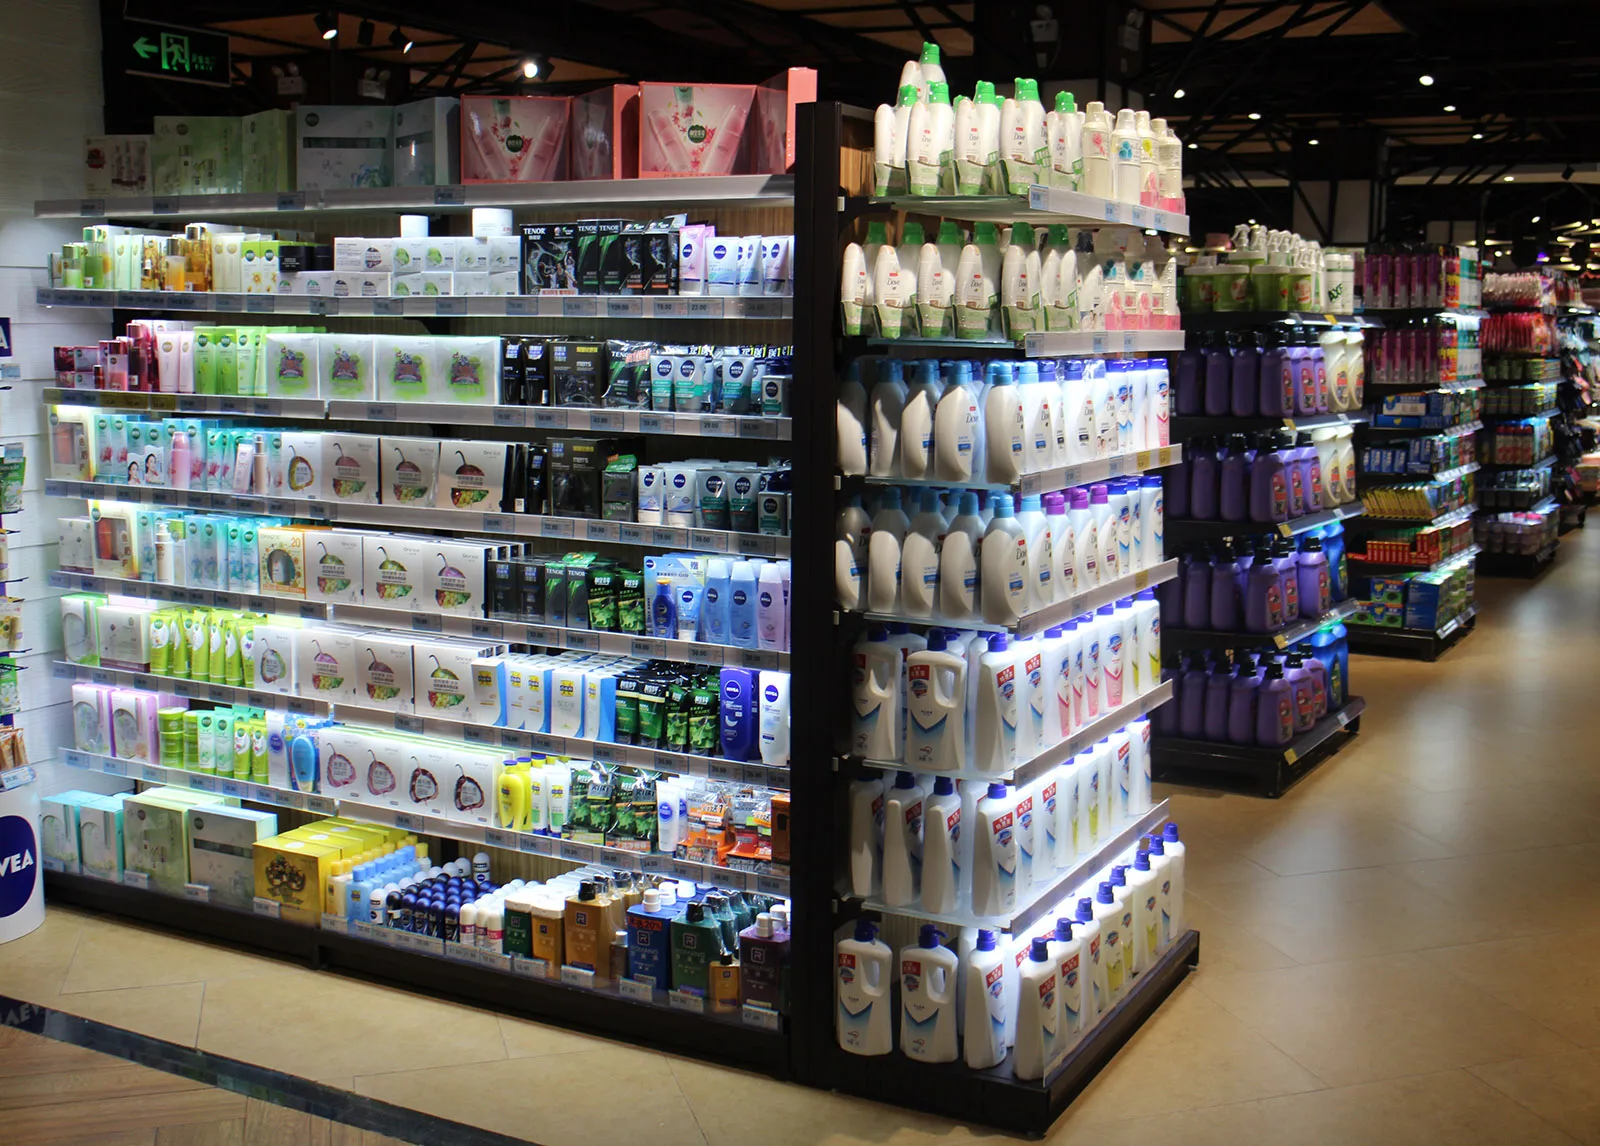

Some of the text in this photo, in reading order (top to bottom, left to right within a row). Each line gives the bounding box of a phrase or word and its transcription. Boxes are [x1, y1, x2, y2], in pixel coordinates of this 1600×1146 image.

[523, 227, 546, 235] TENOR
[578, 225, 597, 234] TENOR
[600, 224, 619, 233] TENOR
[291, 537, 301, 548] 20
